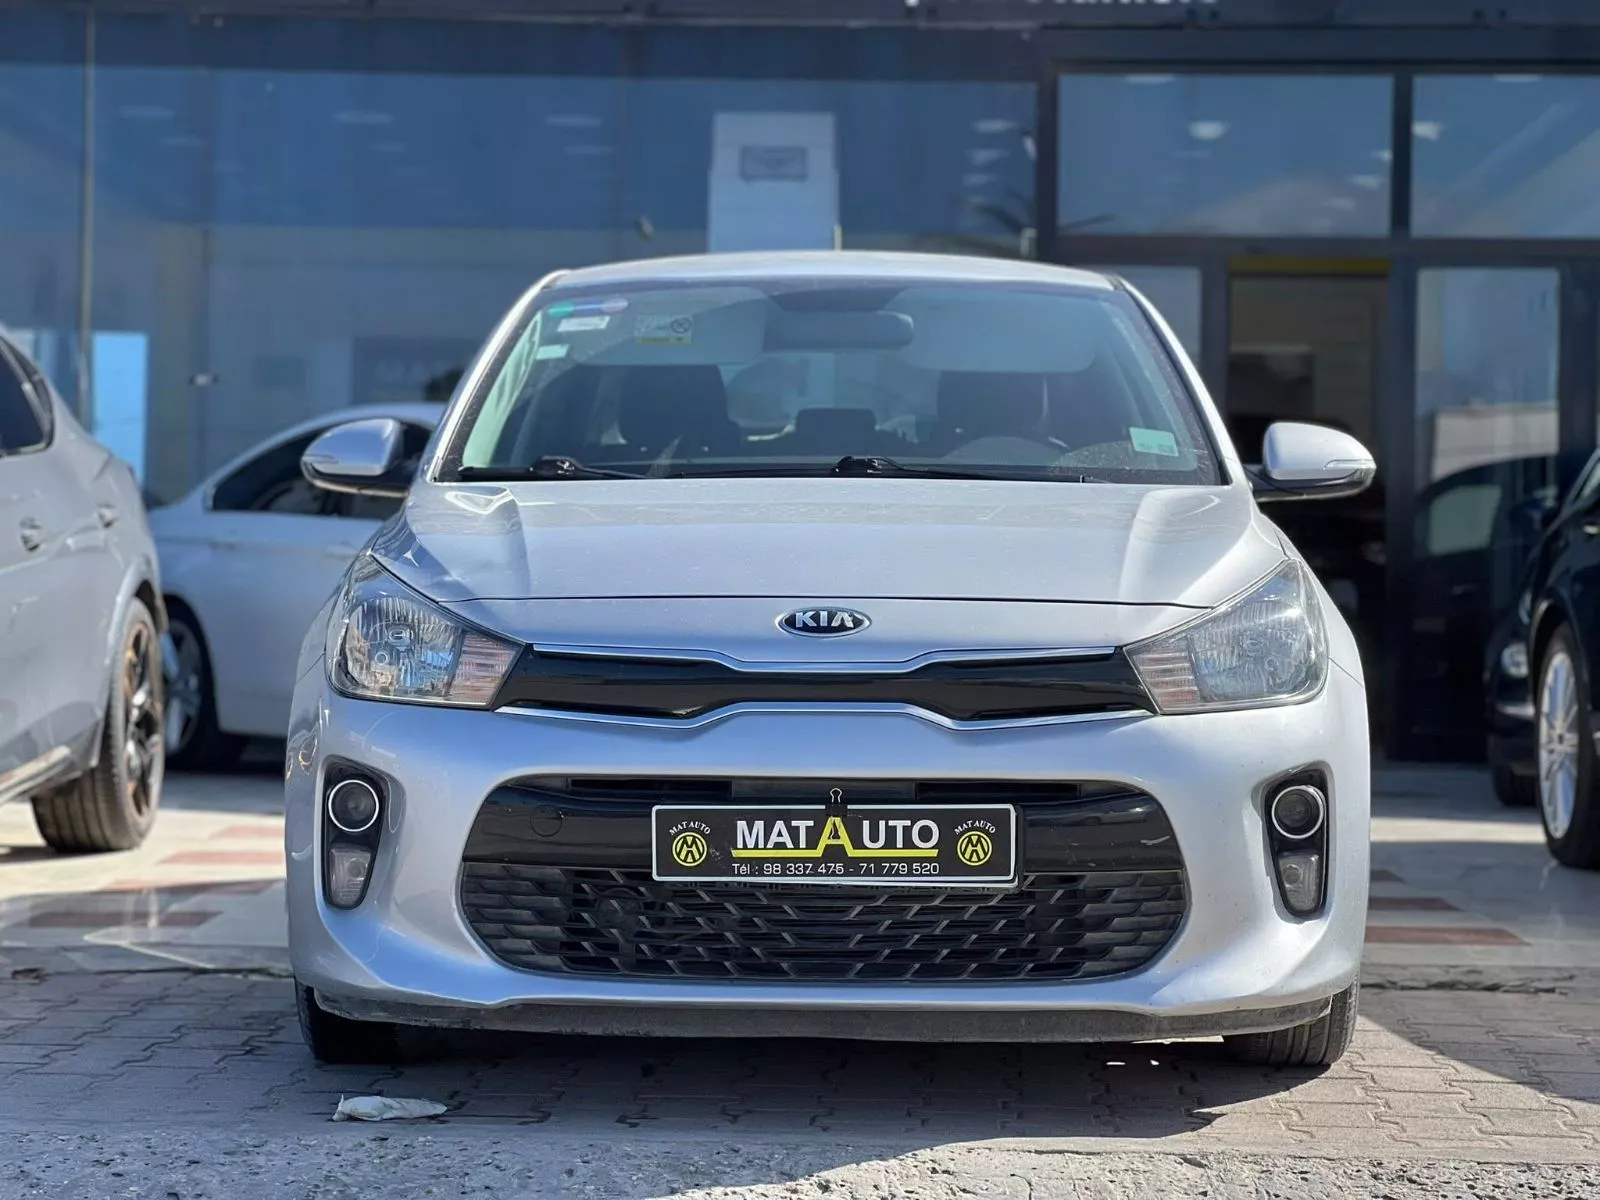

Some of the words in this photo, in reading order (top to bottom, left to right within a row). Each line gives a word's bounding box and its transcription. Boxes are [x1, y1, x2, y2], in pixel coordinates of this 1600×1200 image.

[795, 610, 855, 629] KIA
[669, 821, 688, 836] MAT
[688, 820, 711, 835] AUTO
[954, 820, 973, 835] MAT
[973, 819, 996, 834] AUTO
[763, 863, 782, 875] 98
[786, 863, 813, 875] 337
[818, 863, 844, 875] 475
[859, 863, 875, 875] 71
[881, 863, 908, 875] 779
[912, 863, 940, 875] 520
